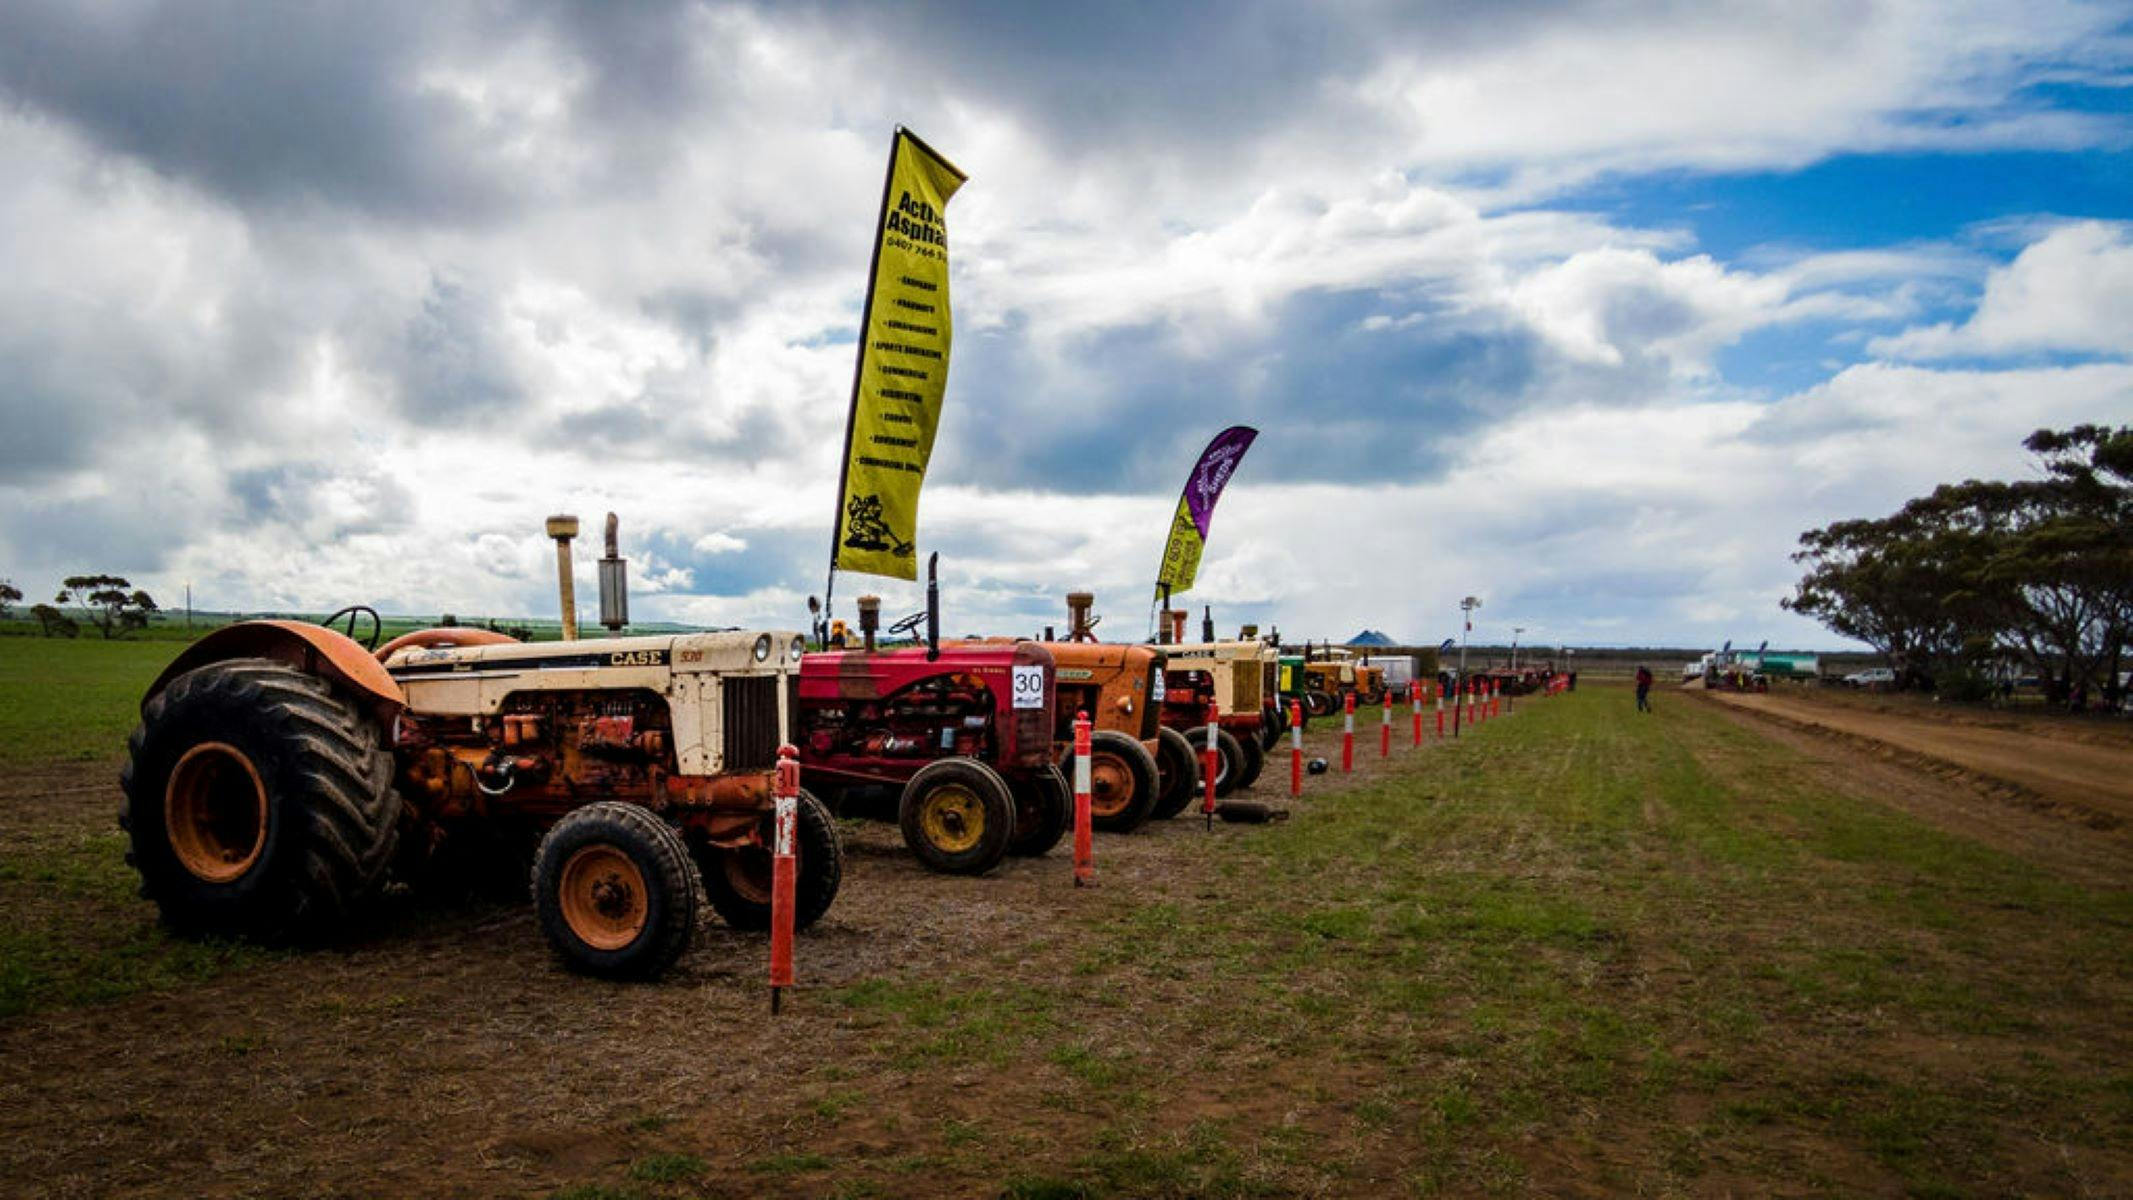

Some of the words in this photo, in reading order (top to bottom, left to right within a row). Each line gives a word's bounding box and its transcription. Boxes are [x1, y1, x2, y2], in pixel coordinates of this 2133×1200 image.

[899, 191, 945, 228] Activ
[887, 211, 947, 248] Aspha
[611, 650, 662, 665] CASE
[1015, 673, 1042, 693] 30
